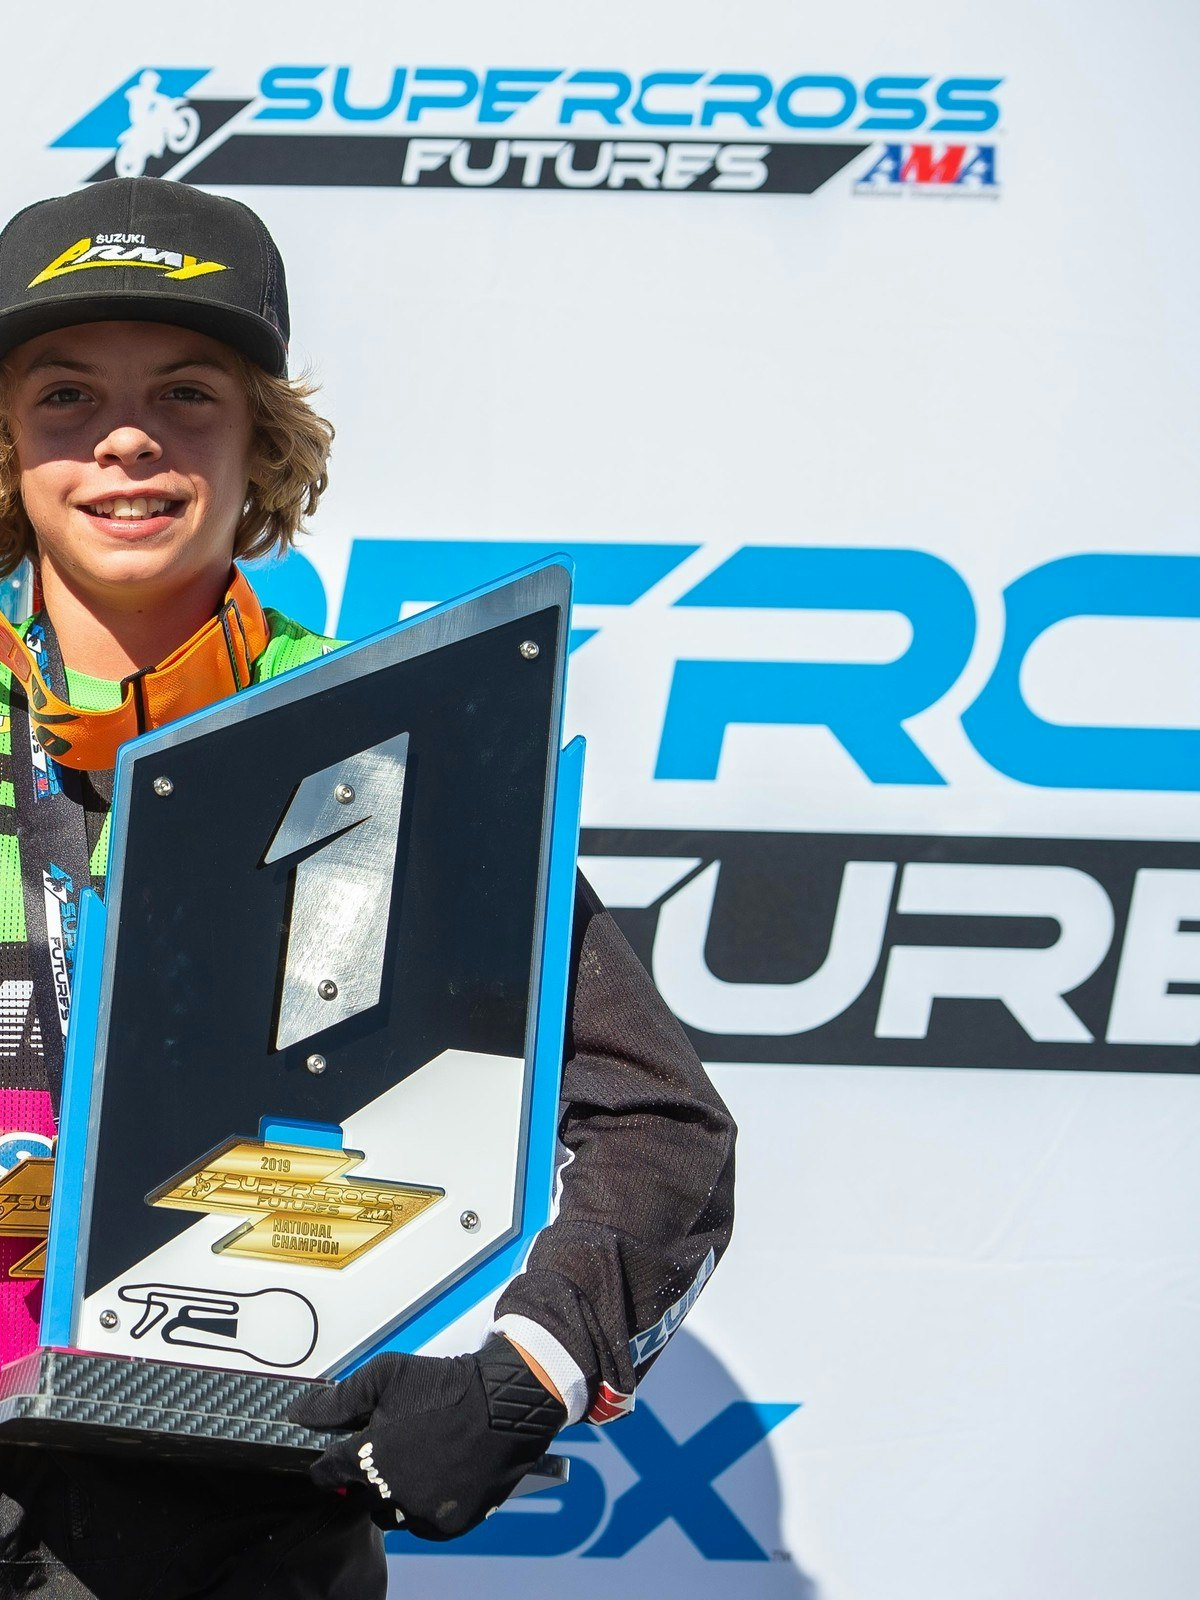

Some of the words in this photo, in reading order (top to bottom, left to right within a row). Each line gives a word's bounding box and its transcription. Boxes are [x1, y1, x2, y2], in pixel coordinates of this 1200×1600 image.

[252, 66, 1002, 132] SUPERCROSS
[402, 138, 772, 190] FUTURES
[854, 143, 1000, 185] AMA
[96, 233, 145, 244] SUZUKI
[50, 936, 71, 1022] FUTURES
[261, 1157, 291, 1173] 2019
[221, 1174, 396, 1209] SUPERCROSS
[257, 1196, 340, 1216] FUTURES
[273, 1219, 333, 1239] NATIONAL
[272, 1235, 340, 1255] CHAMPION
